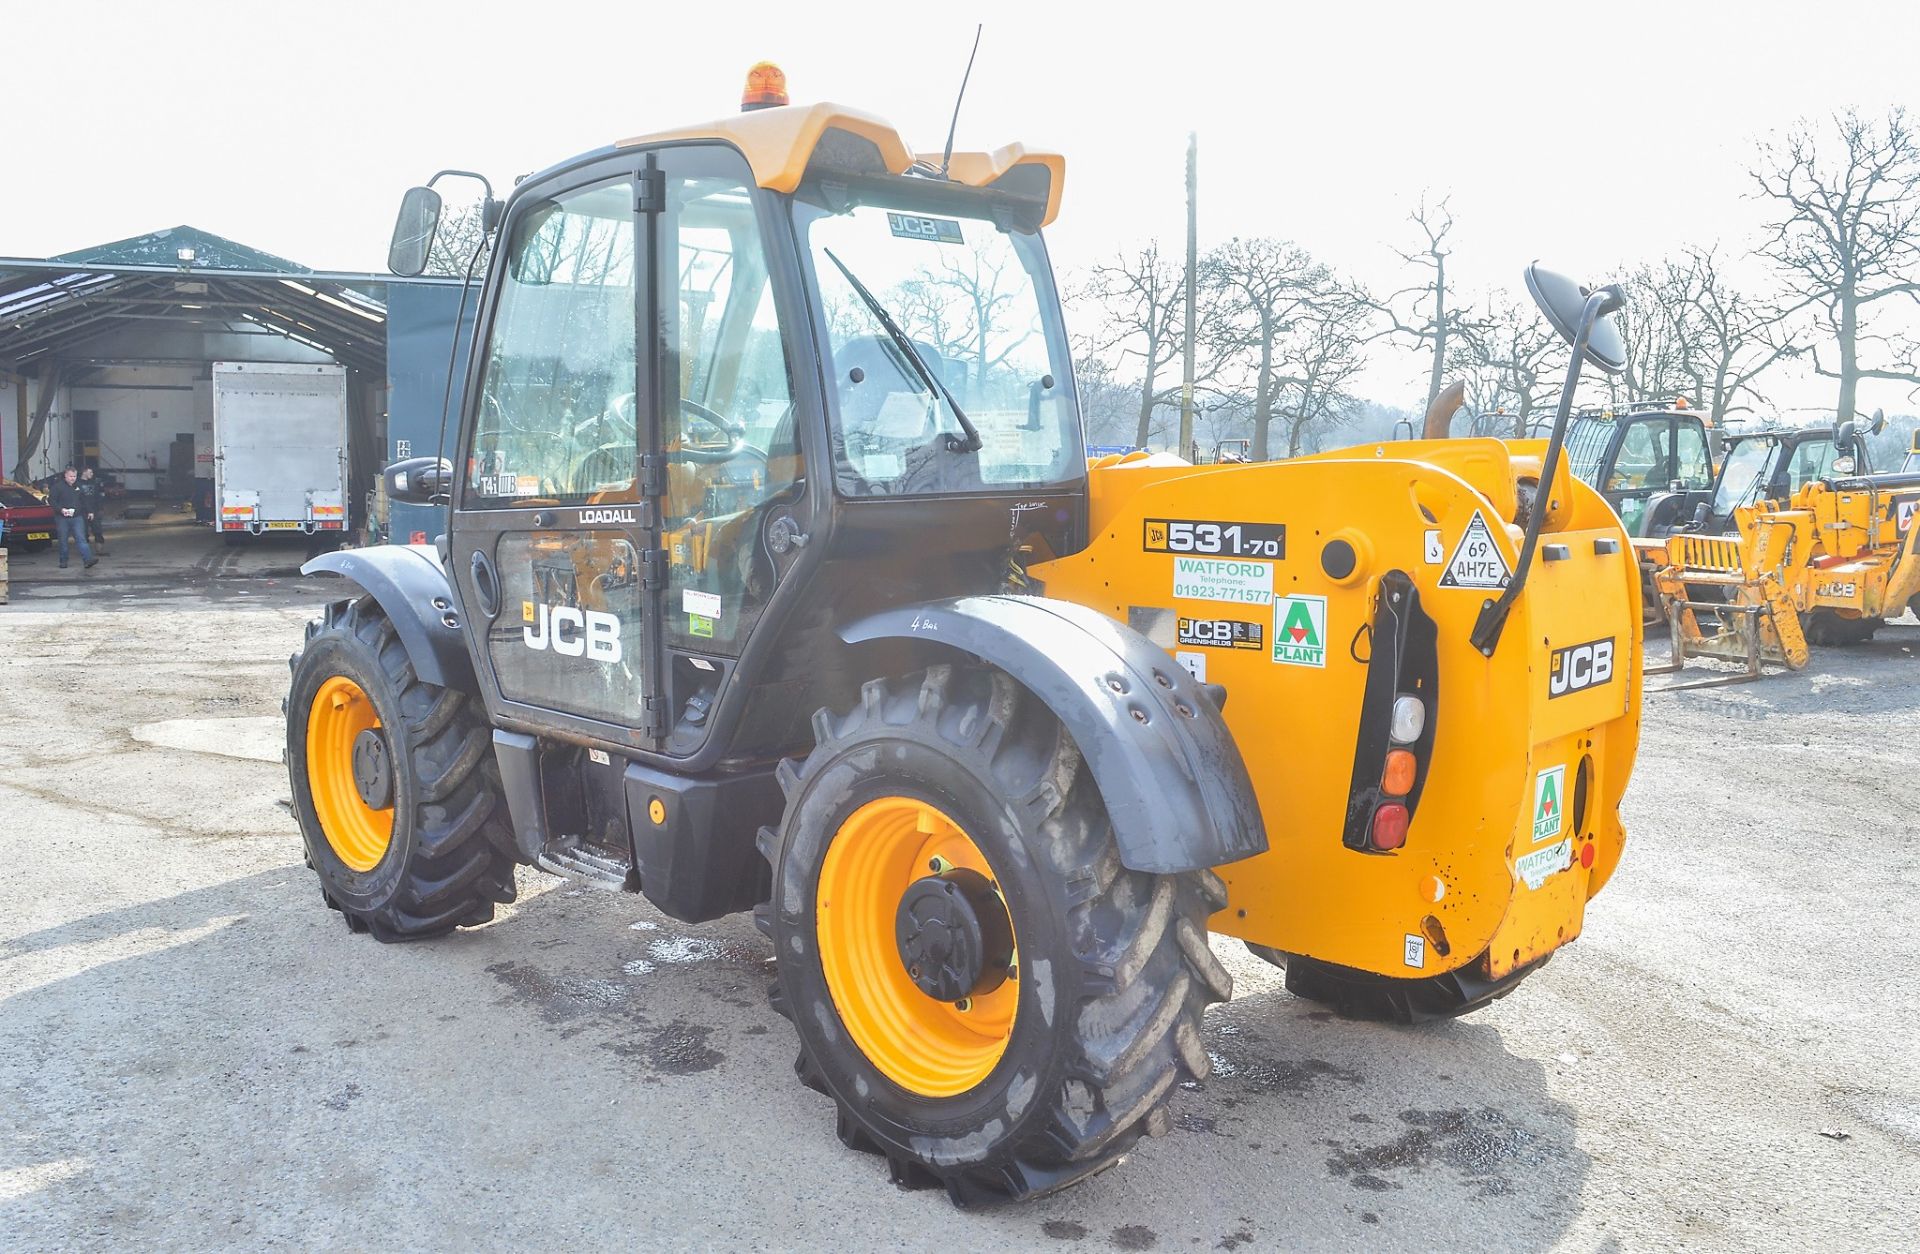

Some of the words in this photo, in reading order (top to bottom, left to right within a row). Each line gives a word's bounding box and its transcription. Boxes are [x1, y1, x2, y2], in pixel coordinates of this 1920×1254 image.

[891, 216, 937, 234] JCB
[579, 510, 636, 524] LOADALL
[1168, 522, 1279, 556] 531-70
[1468, 541, 1488, 558] 69
[1179, 559, 1265, 578] WATFORD
[1457, 561, 1497, 578] AH7E
[1200, 575, 1246, 586] Telephone:
[1175, 583, 1271, 603] 01923-771577
[523, 603, 622, 664] JCB
[1180, 620, 1232, 640] JCB
[1180, 637, 1232, 647] GREENSHIELDS
[1274, 645, 1323, 663] PLANT
[1550, 641, 1613, 694] JCB
[1534, 817, 1560, 838] PLANT
[1517, 843, 1568, 873] WATFORD
